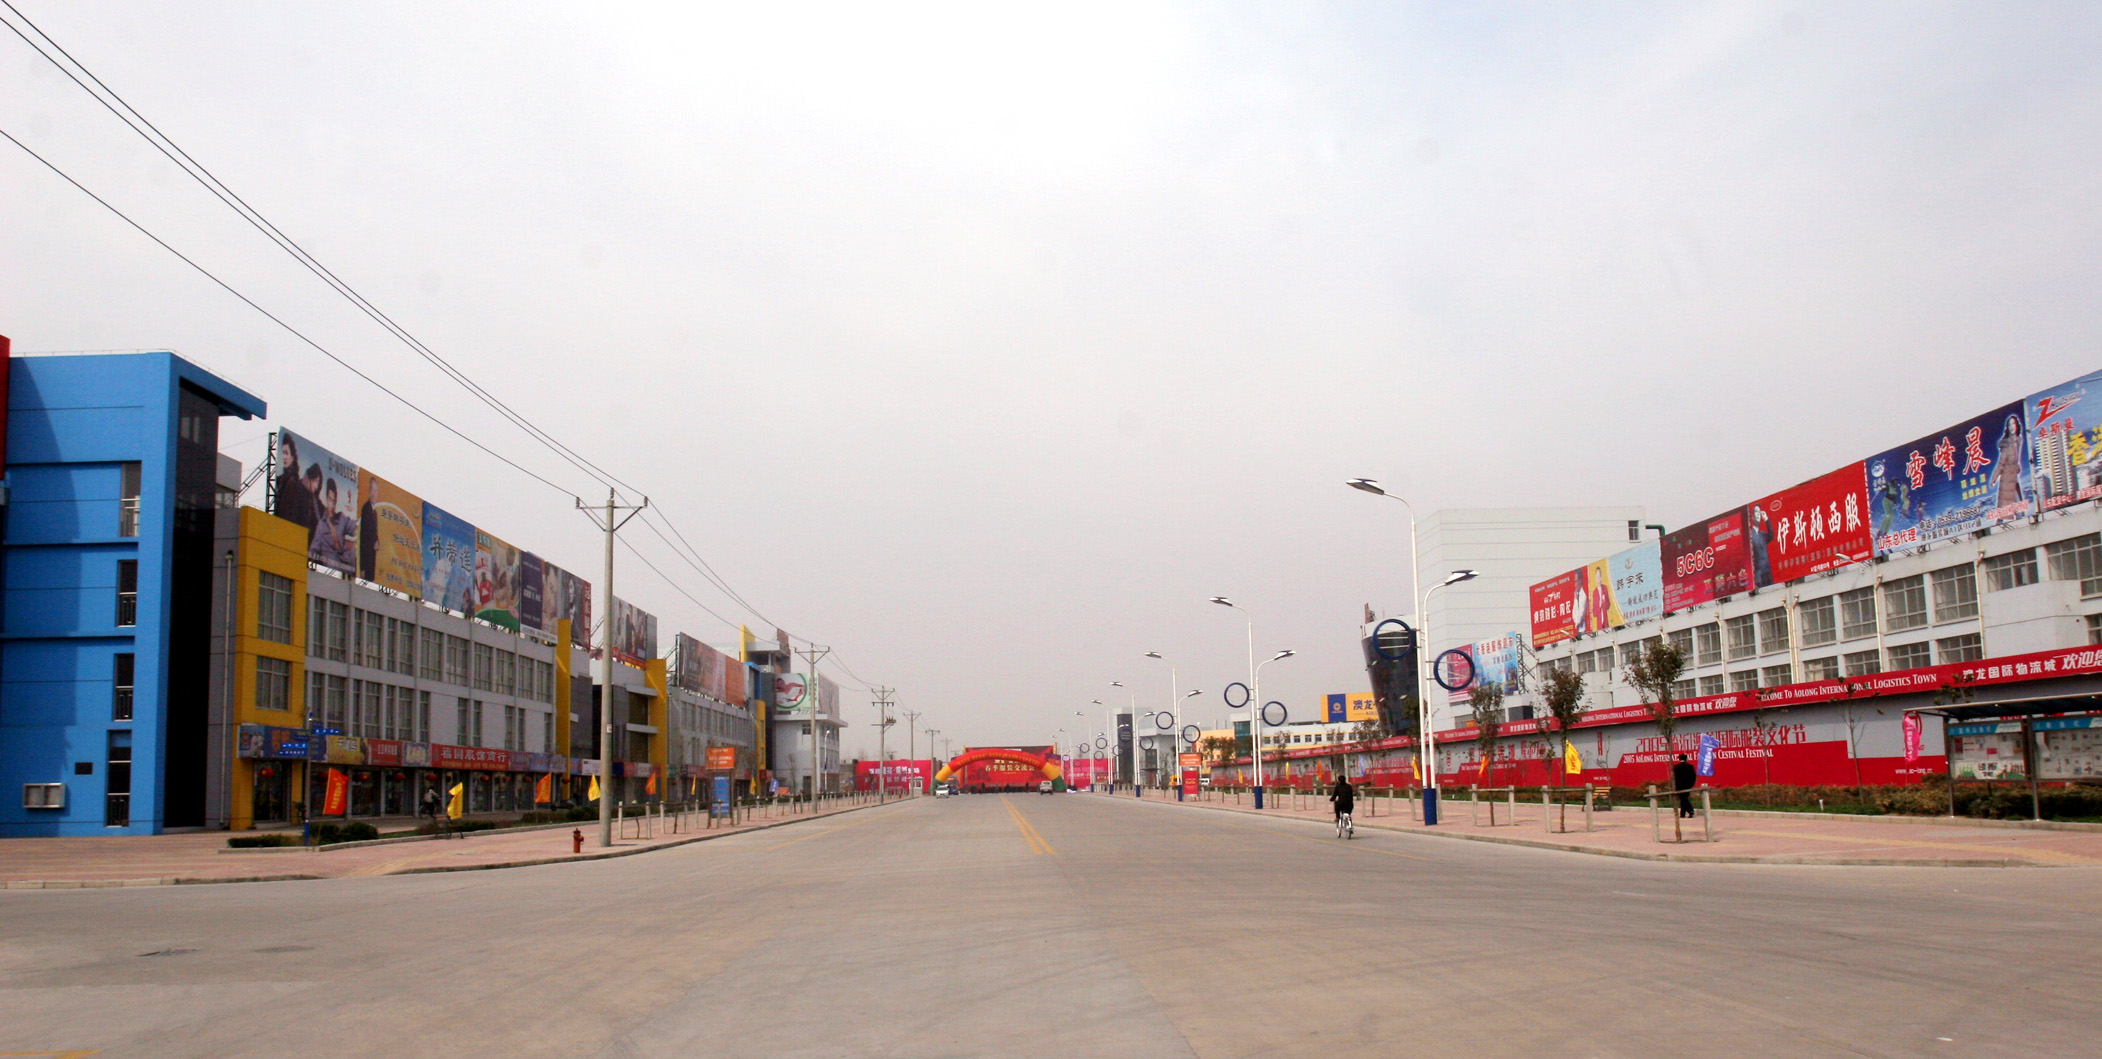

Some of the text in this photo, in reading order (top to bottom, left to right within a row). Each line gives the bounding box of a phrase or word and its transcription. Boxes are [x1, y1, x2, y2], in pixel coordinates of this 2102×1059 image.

[1905, 426, 1991, 491] 雪峰晨
[1777, 492, 1862, 555] 伊斯顿西服
[1877, 527, 1917, 550] 山东总代理
[429, 532, 472, 573] 并蒂莲
[1676, 546, 1715, 577] 5C6C
[1353, 699, 1377, 711] 澳龙
[1672, 701, 1713, 715] 龙国际物流城
